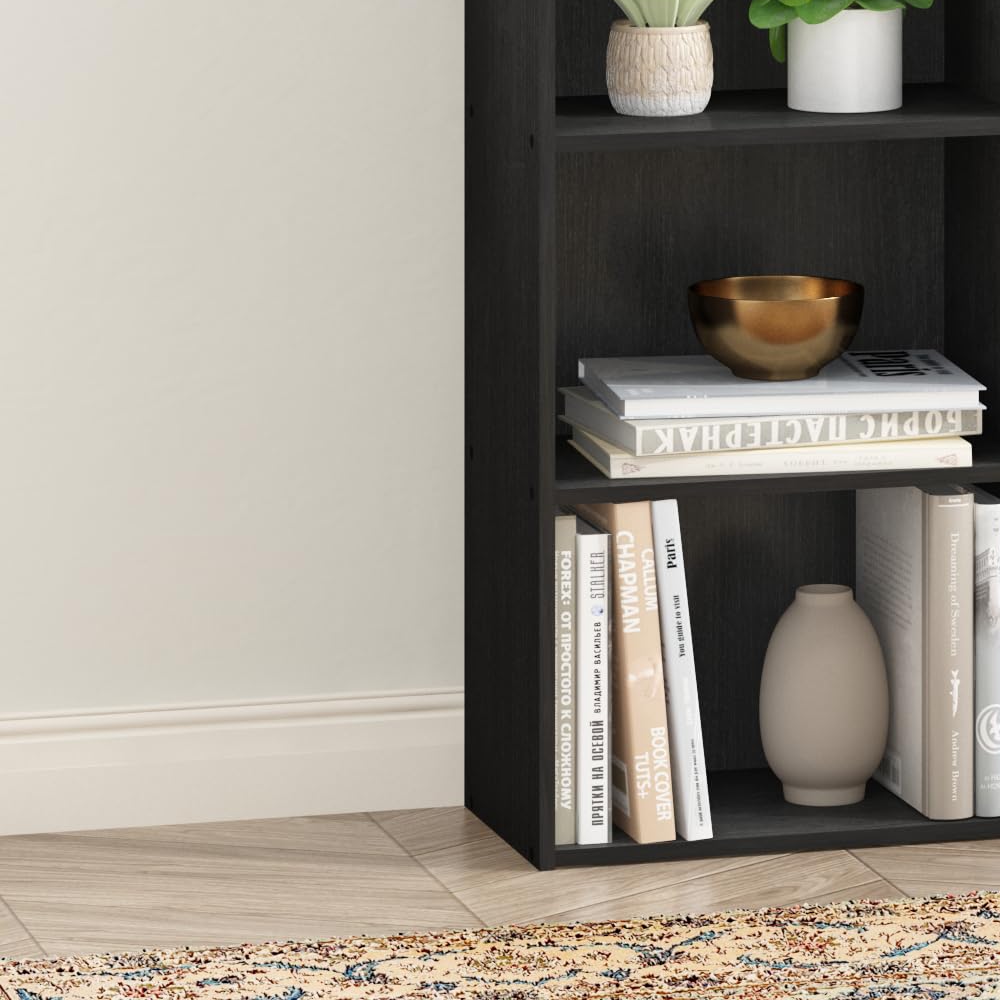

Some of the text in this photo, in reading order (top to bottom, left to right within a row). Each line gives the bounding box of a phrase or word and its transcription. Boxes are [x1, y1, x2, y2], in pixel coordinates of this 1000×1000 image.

[850, 350, 931, 378] Paris
[654, 409, 963, 454] БОРИС ПАСТЕРНАК
[616, 531, 641, 633] CHAPMAN
[641, 548, 658, 611] CALLUM
[664, 538, 678, 569] Paris
[673, 594, 681, 611] visit
[674, 611, 682, 619] to
[948, 532, 960, 658] Dreaming of Sweden
[675, 620, 684, 642] guide
[561, 550, 572, 810] FOREX: ОТ ПРОСТОГО К СЛОЖНОМУ
[593, 621, 602, 713] ВЛАДИМИР ВАСИЛЬЕВ
[589, 720, 604, 826] ПРЯТКИ НА ОСЕВОЙ
[634, 752, 651, 799] TUTS+
[650, 727, 671, 821] BOOK COVER
[951, 730, 960, 801] Andrew Brown
